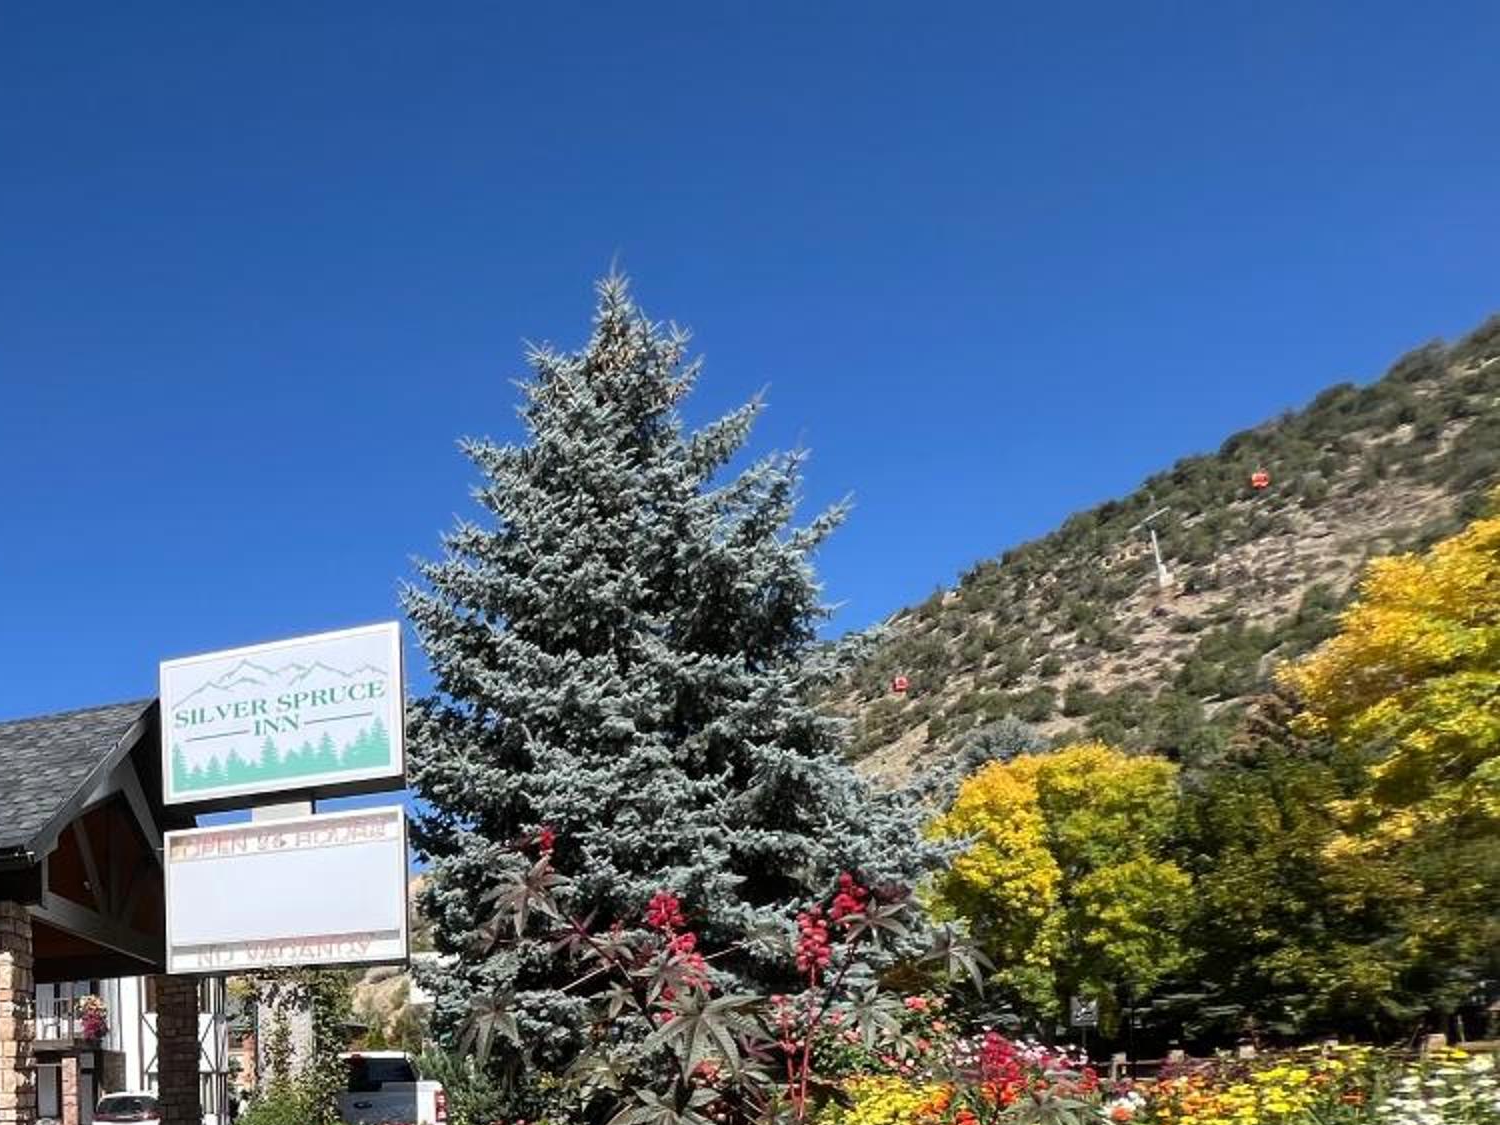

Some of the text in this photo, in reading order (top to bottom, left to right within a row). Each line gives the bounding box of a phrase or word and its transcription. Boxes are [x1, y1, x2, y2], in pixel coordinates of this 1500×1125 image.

[174, 680, 386, 728] SILVER SPRUCE
[254, 714, 300, 736] INN
